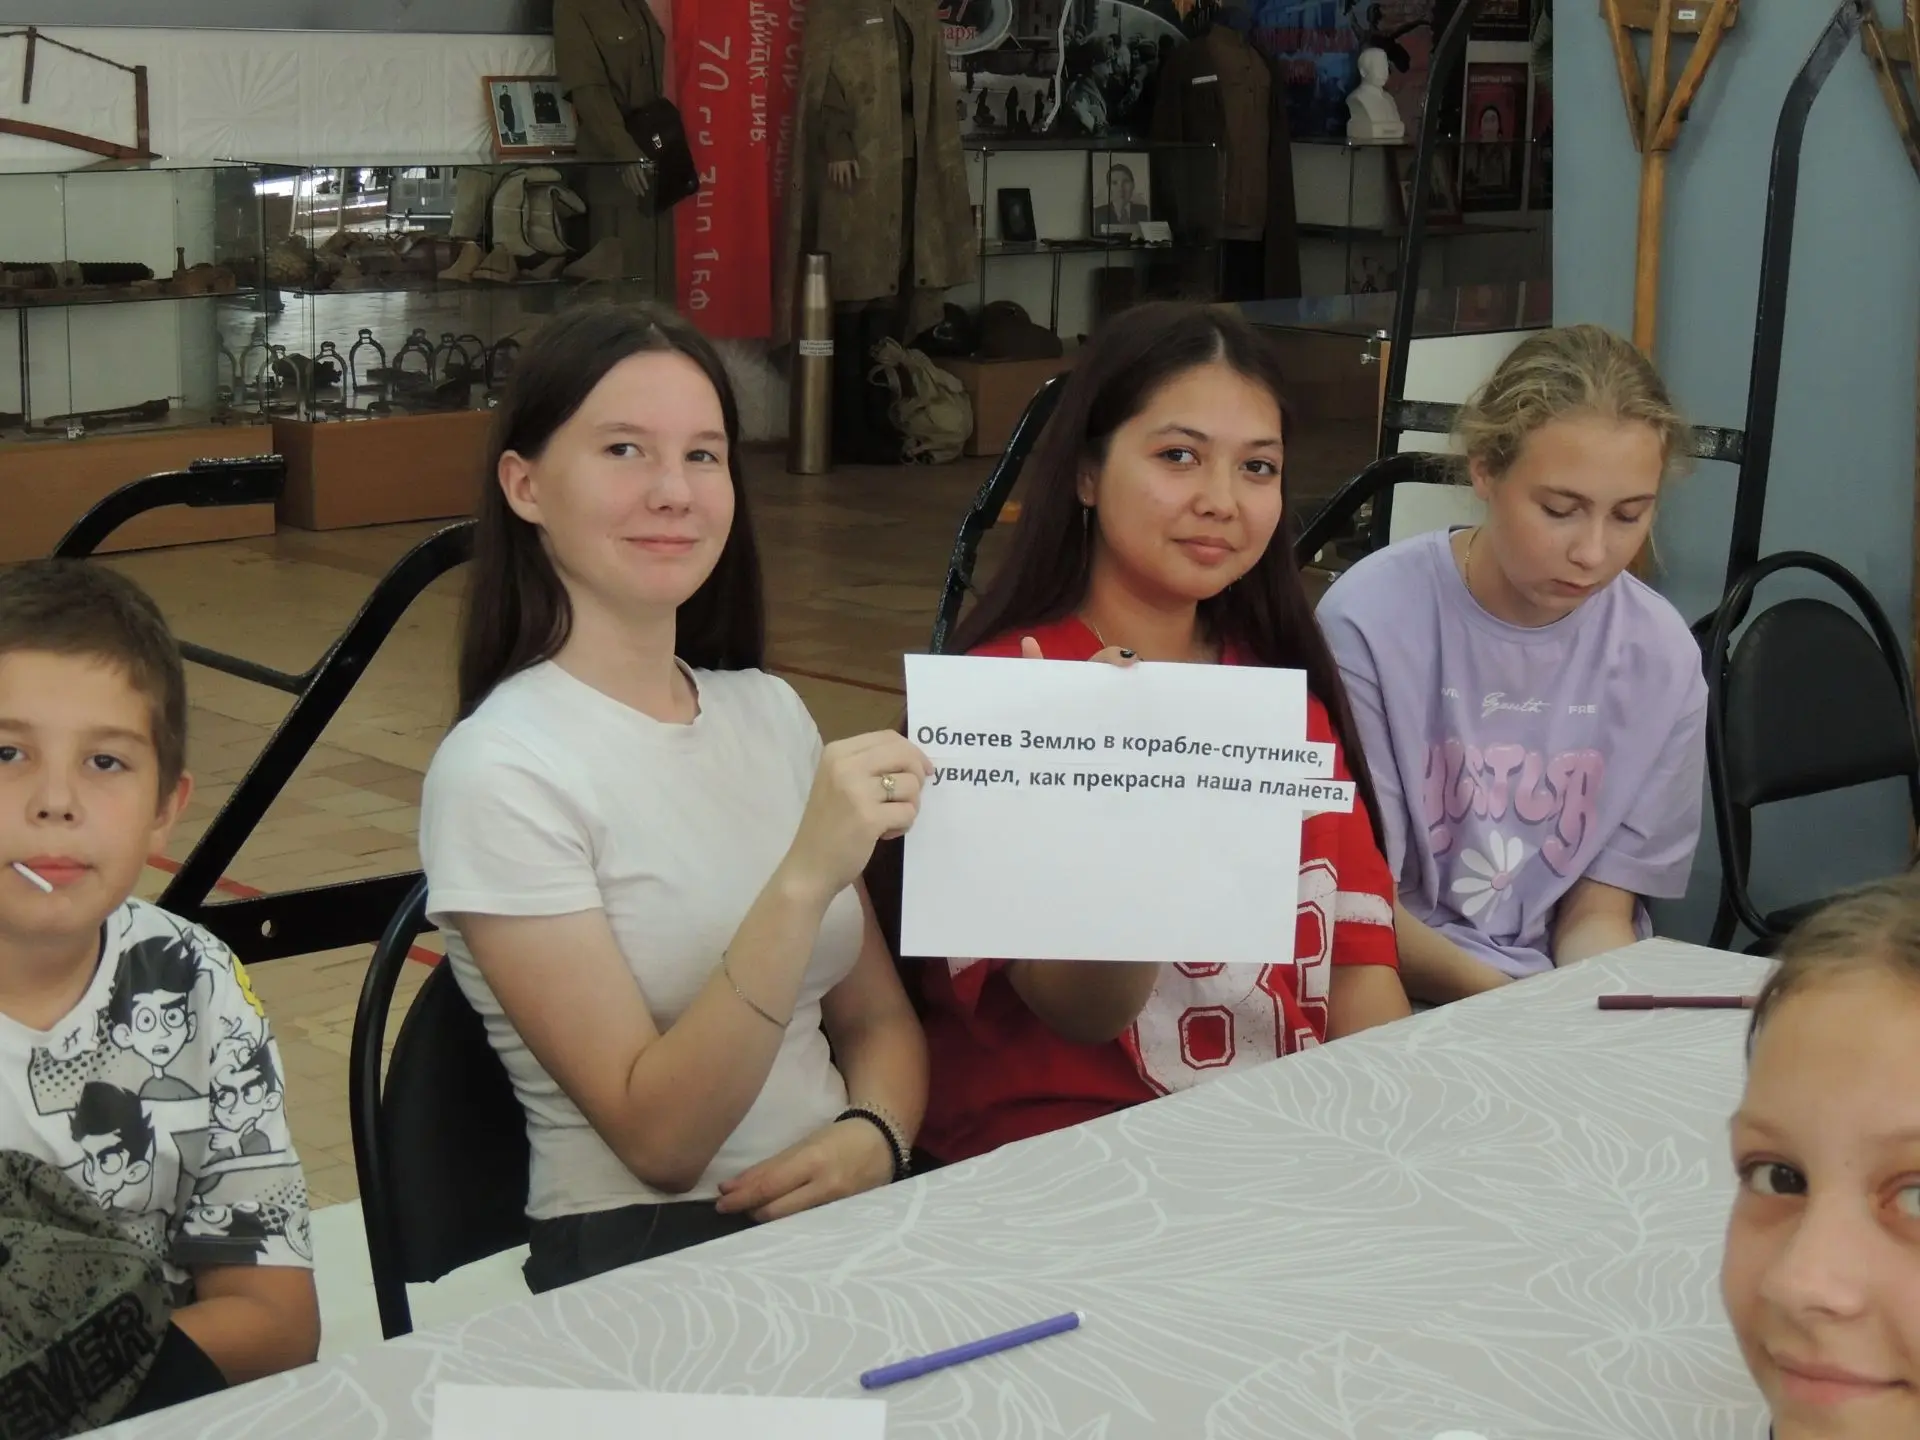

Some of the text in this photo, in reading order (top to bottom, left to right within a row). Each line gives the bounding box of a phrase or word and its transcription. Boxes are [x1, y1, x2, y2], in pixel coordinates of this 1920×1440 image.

[917, 725, 1324, 767] Облетев Землю в корабле-спутнике,
[932, 765, 1349, 801] увидел, как прекрасна наша планета.
